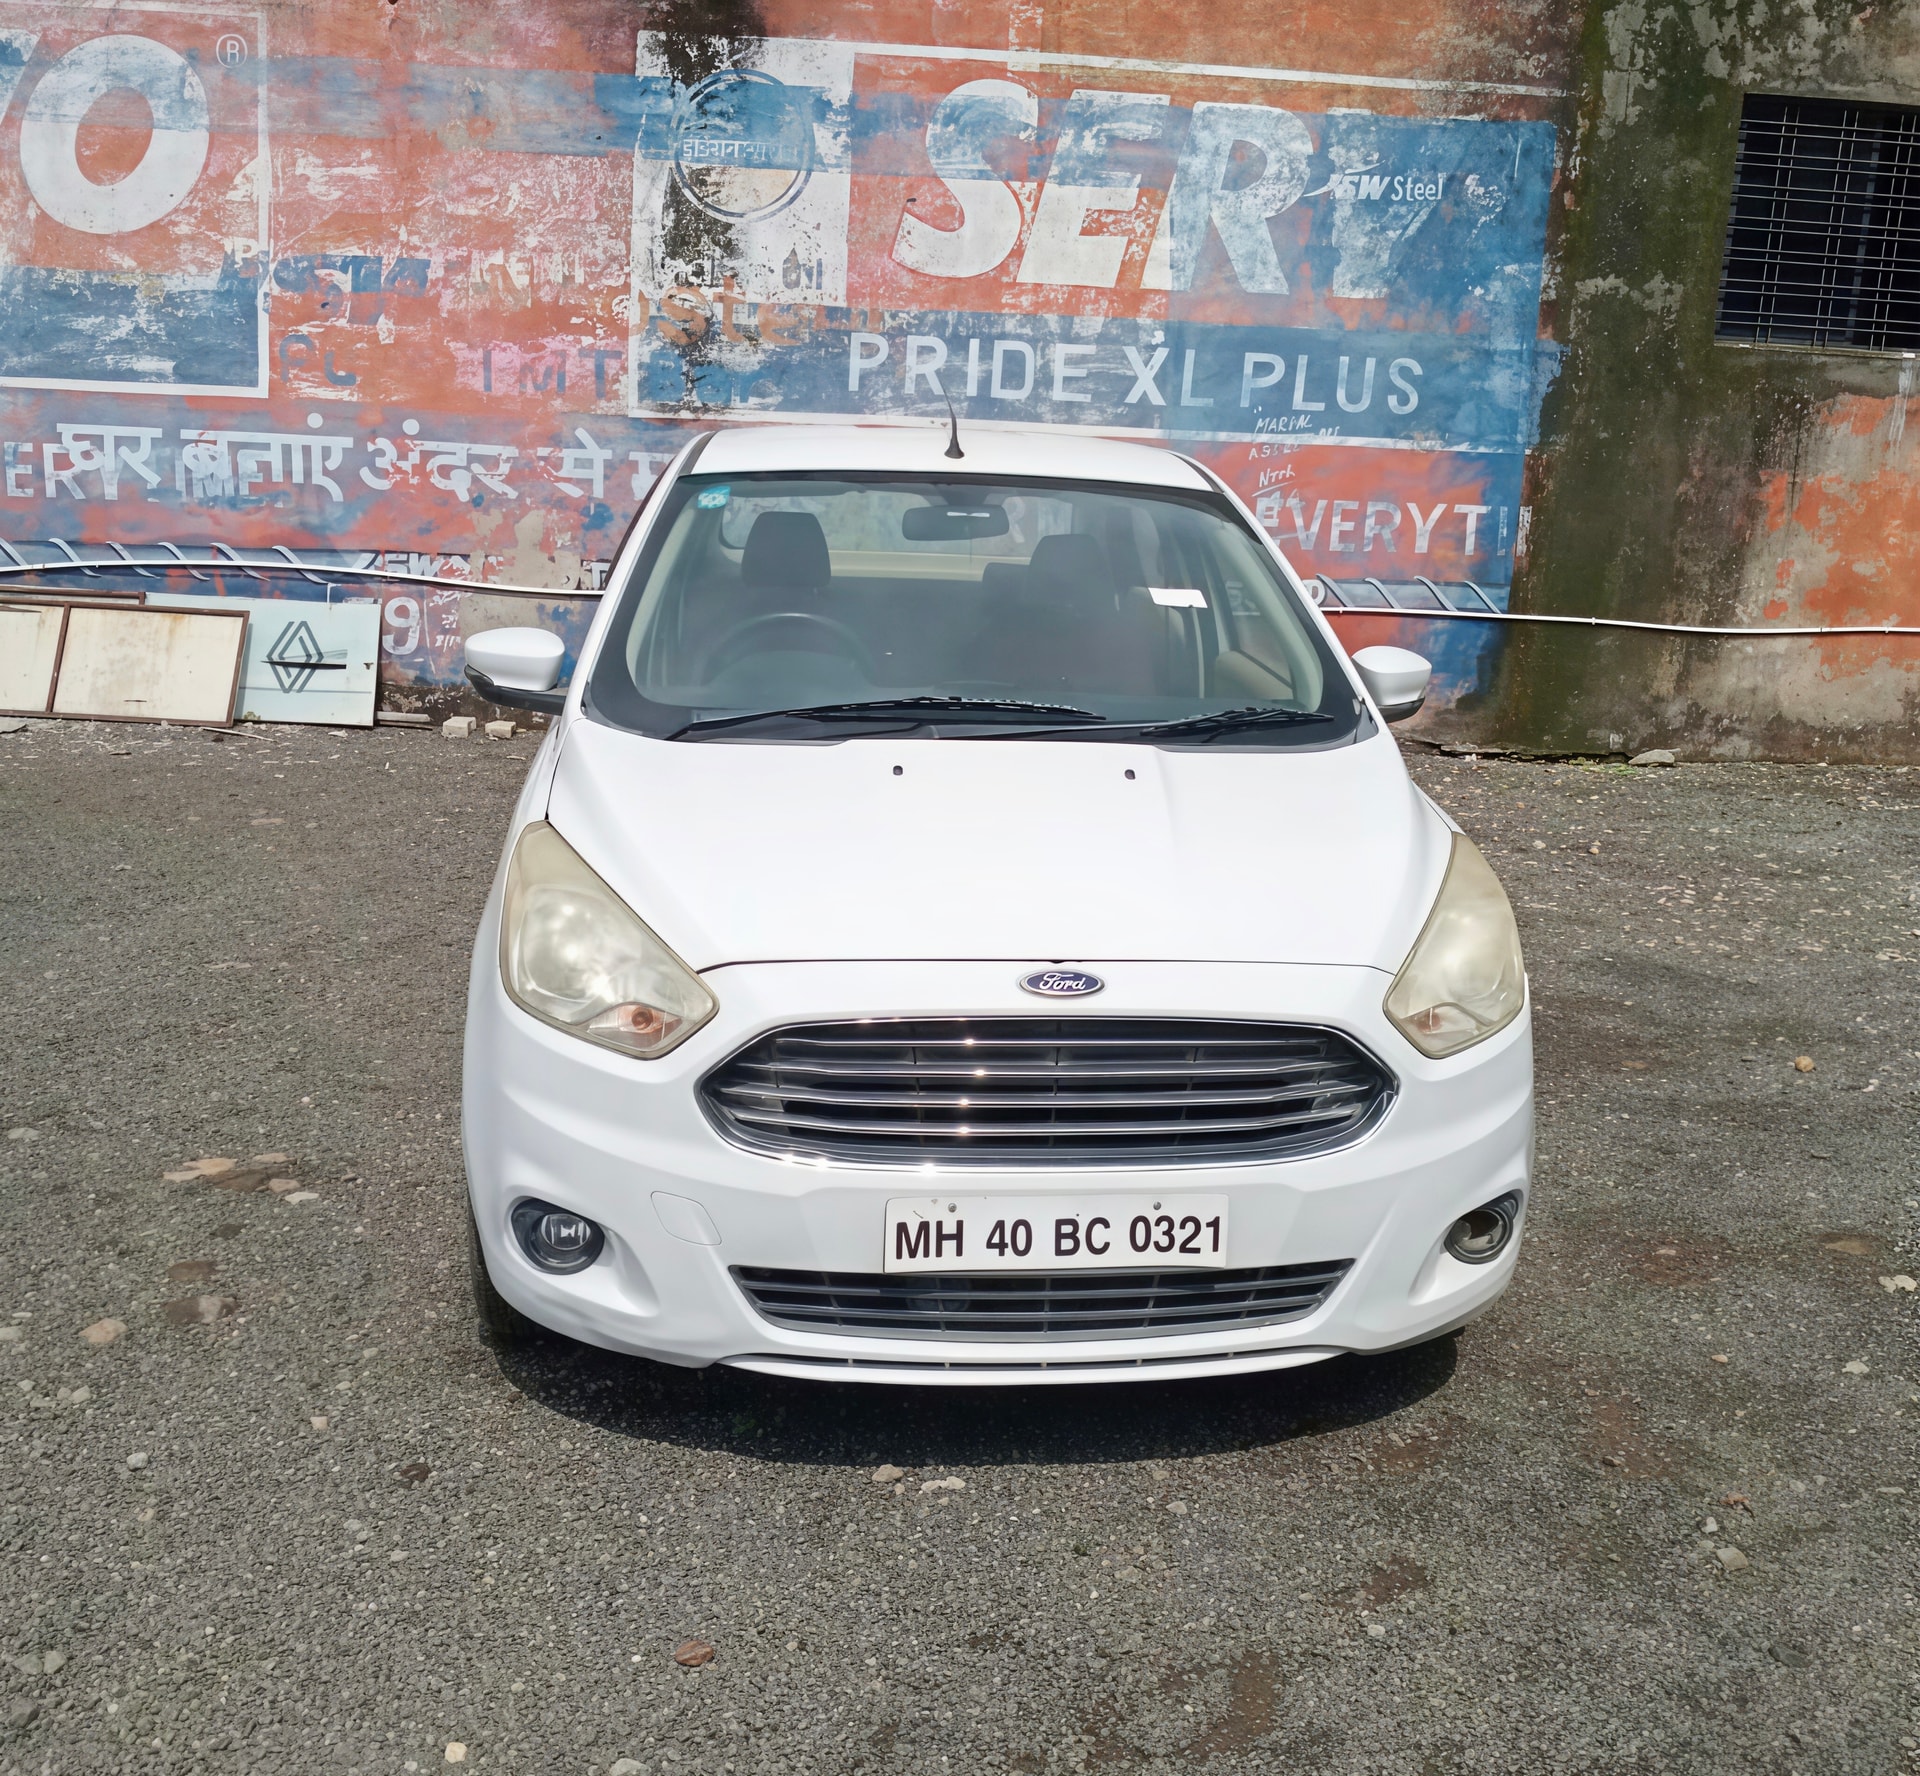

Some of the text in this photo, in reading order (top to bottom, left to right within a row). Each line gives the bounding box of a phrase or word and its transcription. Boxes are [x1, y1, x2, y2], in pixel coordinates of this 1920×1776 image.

[1391, 172, 1444, 201] Steel
[848, 332, 1423, 415] PRIDE XL PLUS
[57, 422, 162, 491] घर
[180, 412, 353, 502] बनाएं
[360, 418, 519, 502] अंदर
[537, 427, 612, 499] से
[1039, 972, 1087, 990] Ford
[895, 1214, 1221, 1260] MH 40 BC 0321
